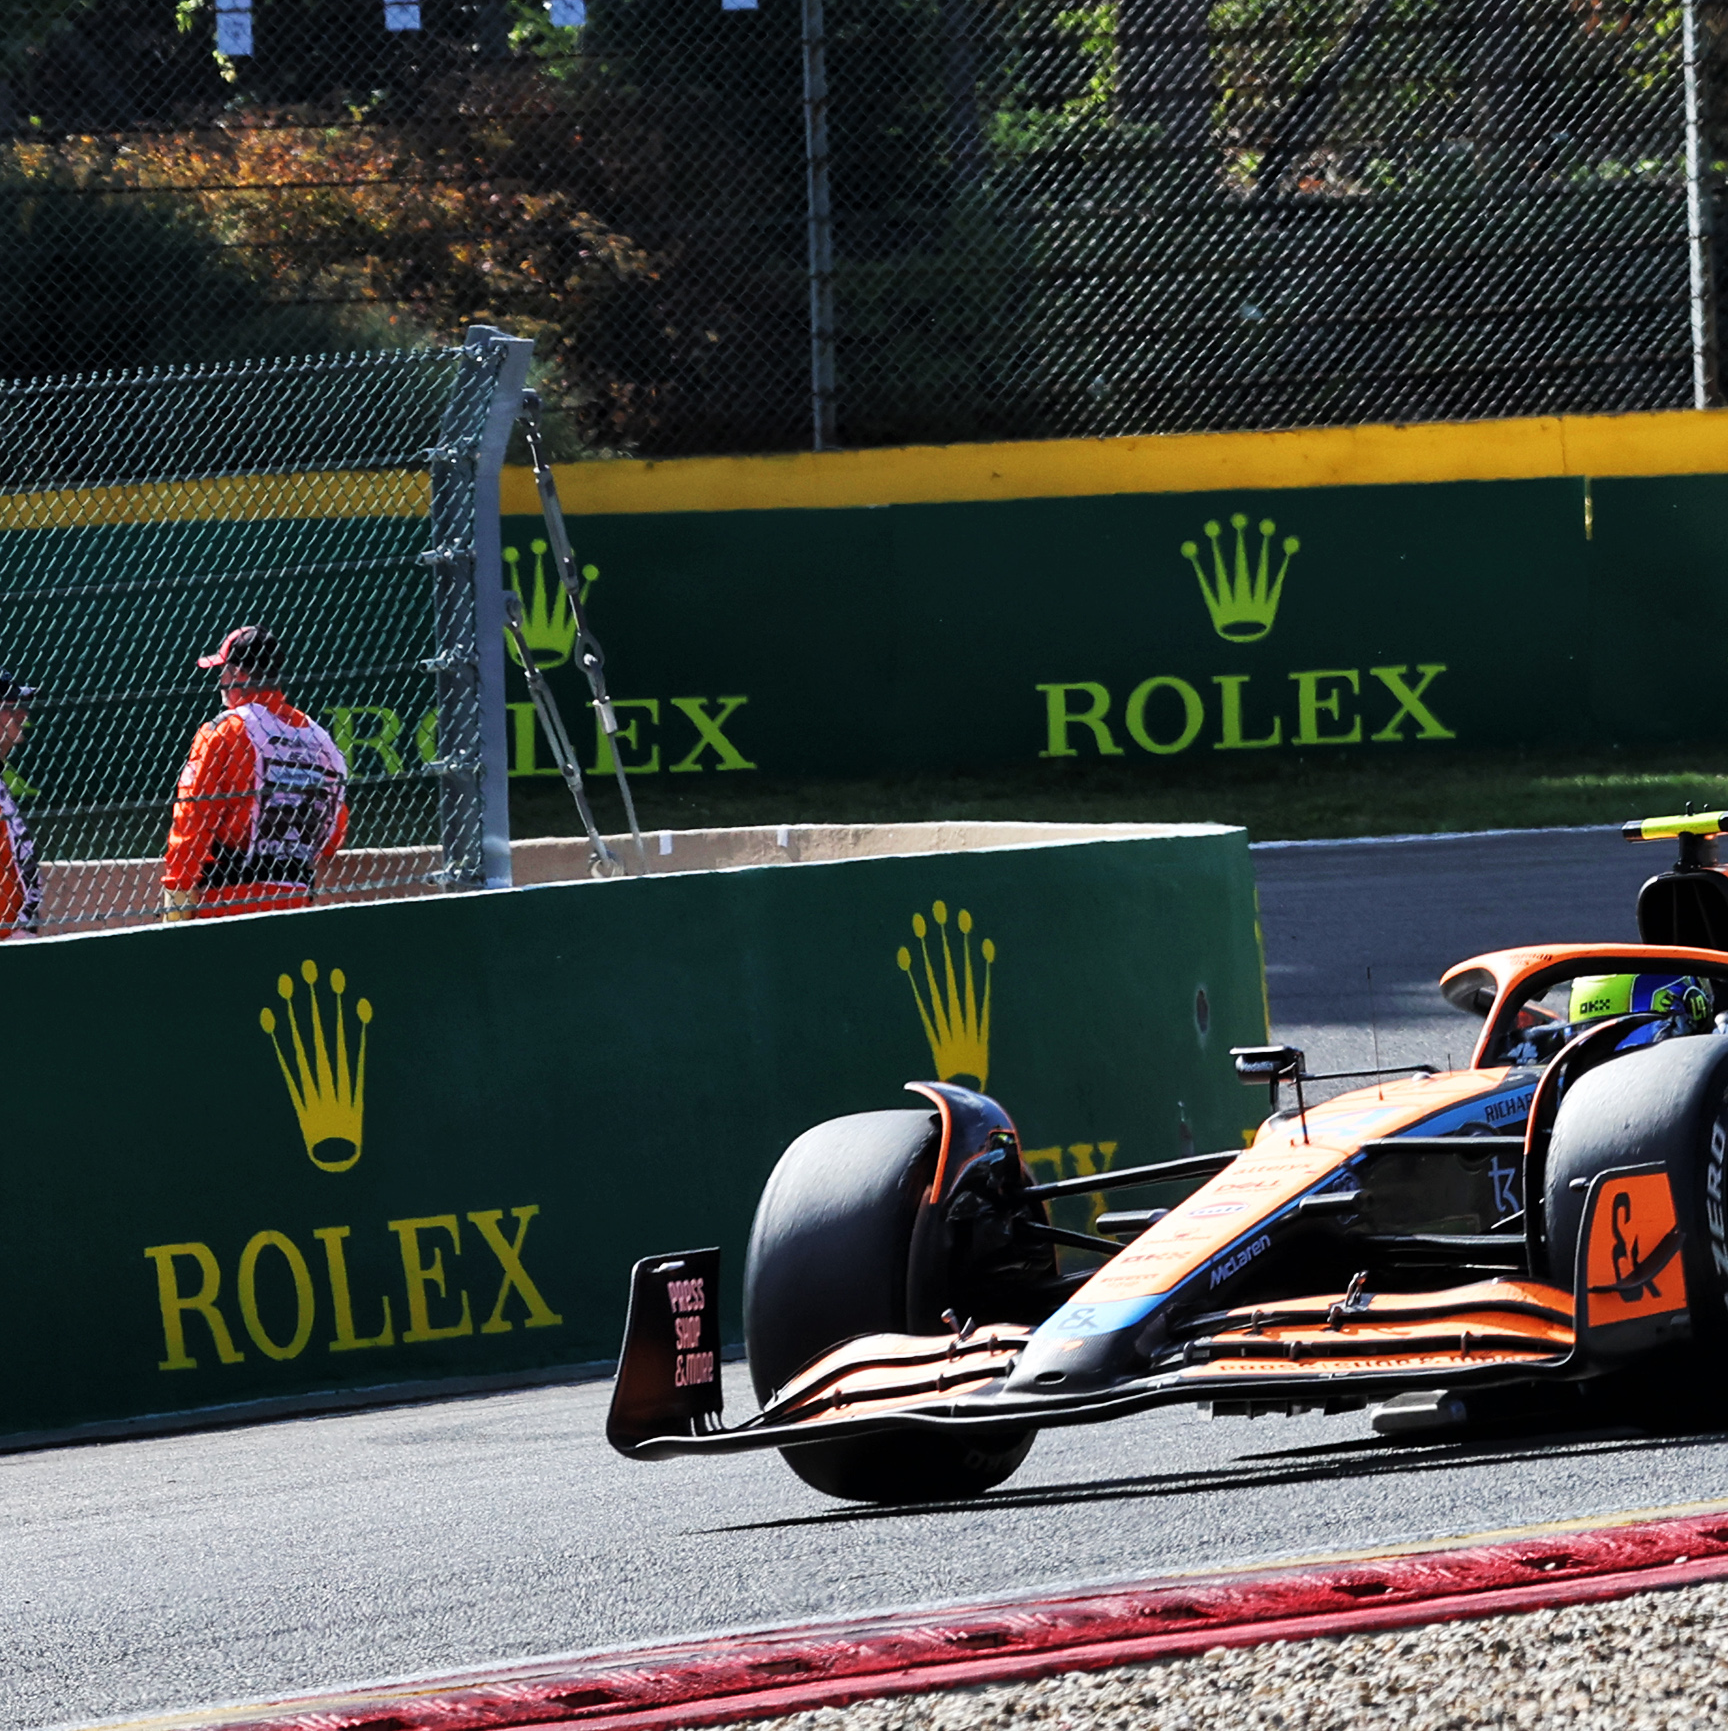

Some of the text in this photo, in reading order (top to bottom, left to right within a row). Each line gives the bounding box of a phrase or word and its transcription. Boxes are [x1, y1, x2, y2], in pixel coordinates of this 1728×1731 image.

[1039, 666, 1453, 758] ROLEX
[1579, 998, 1611, 1014] OKX
[1208, 1233, 1272, 1291] McLaren
[145, 1203, 562, 1371] ROLEX
[667, 1277, 705, 1313] PRESS
[675, 1316, 701, 1350] SHOP
